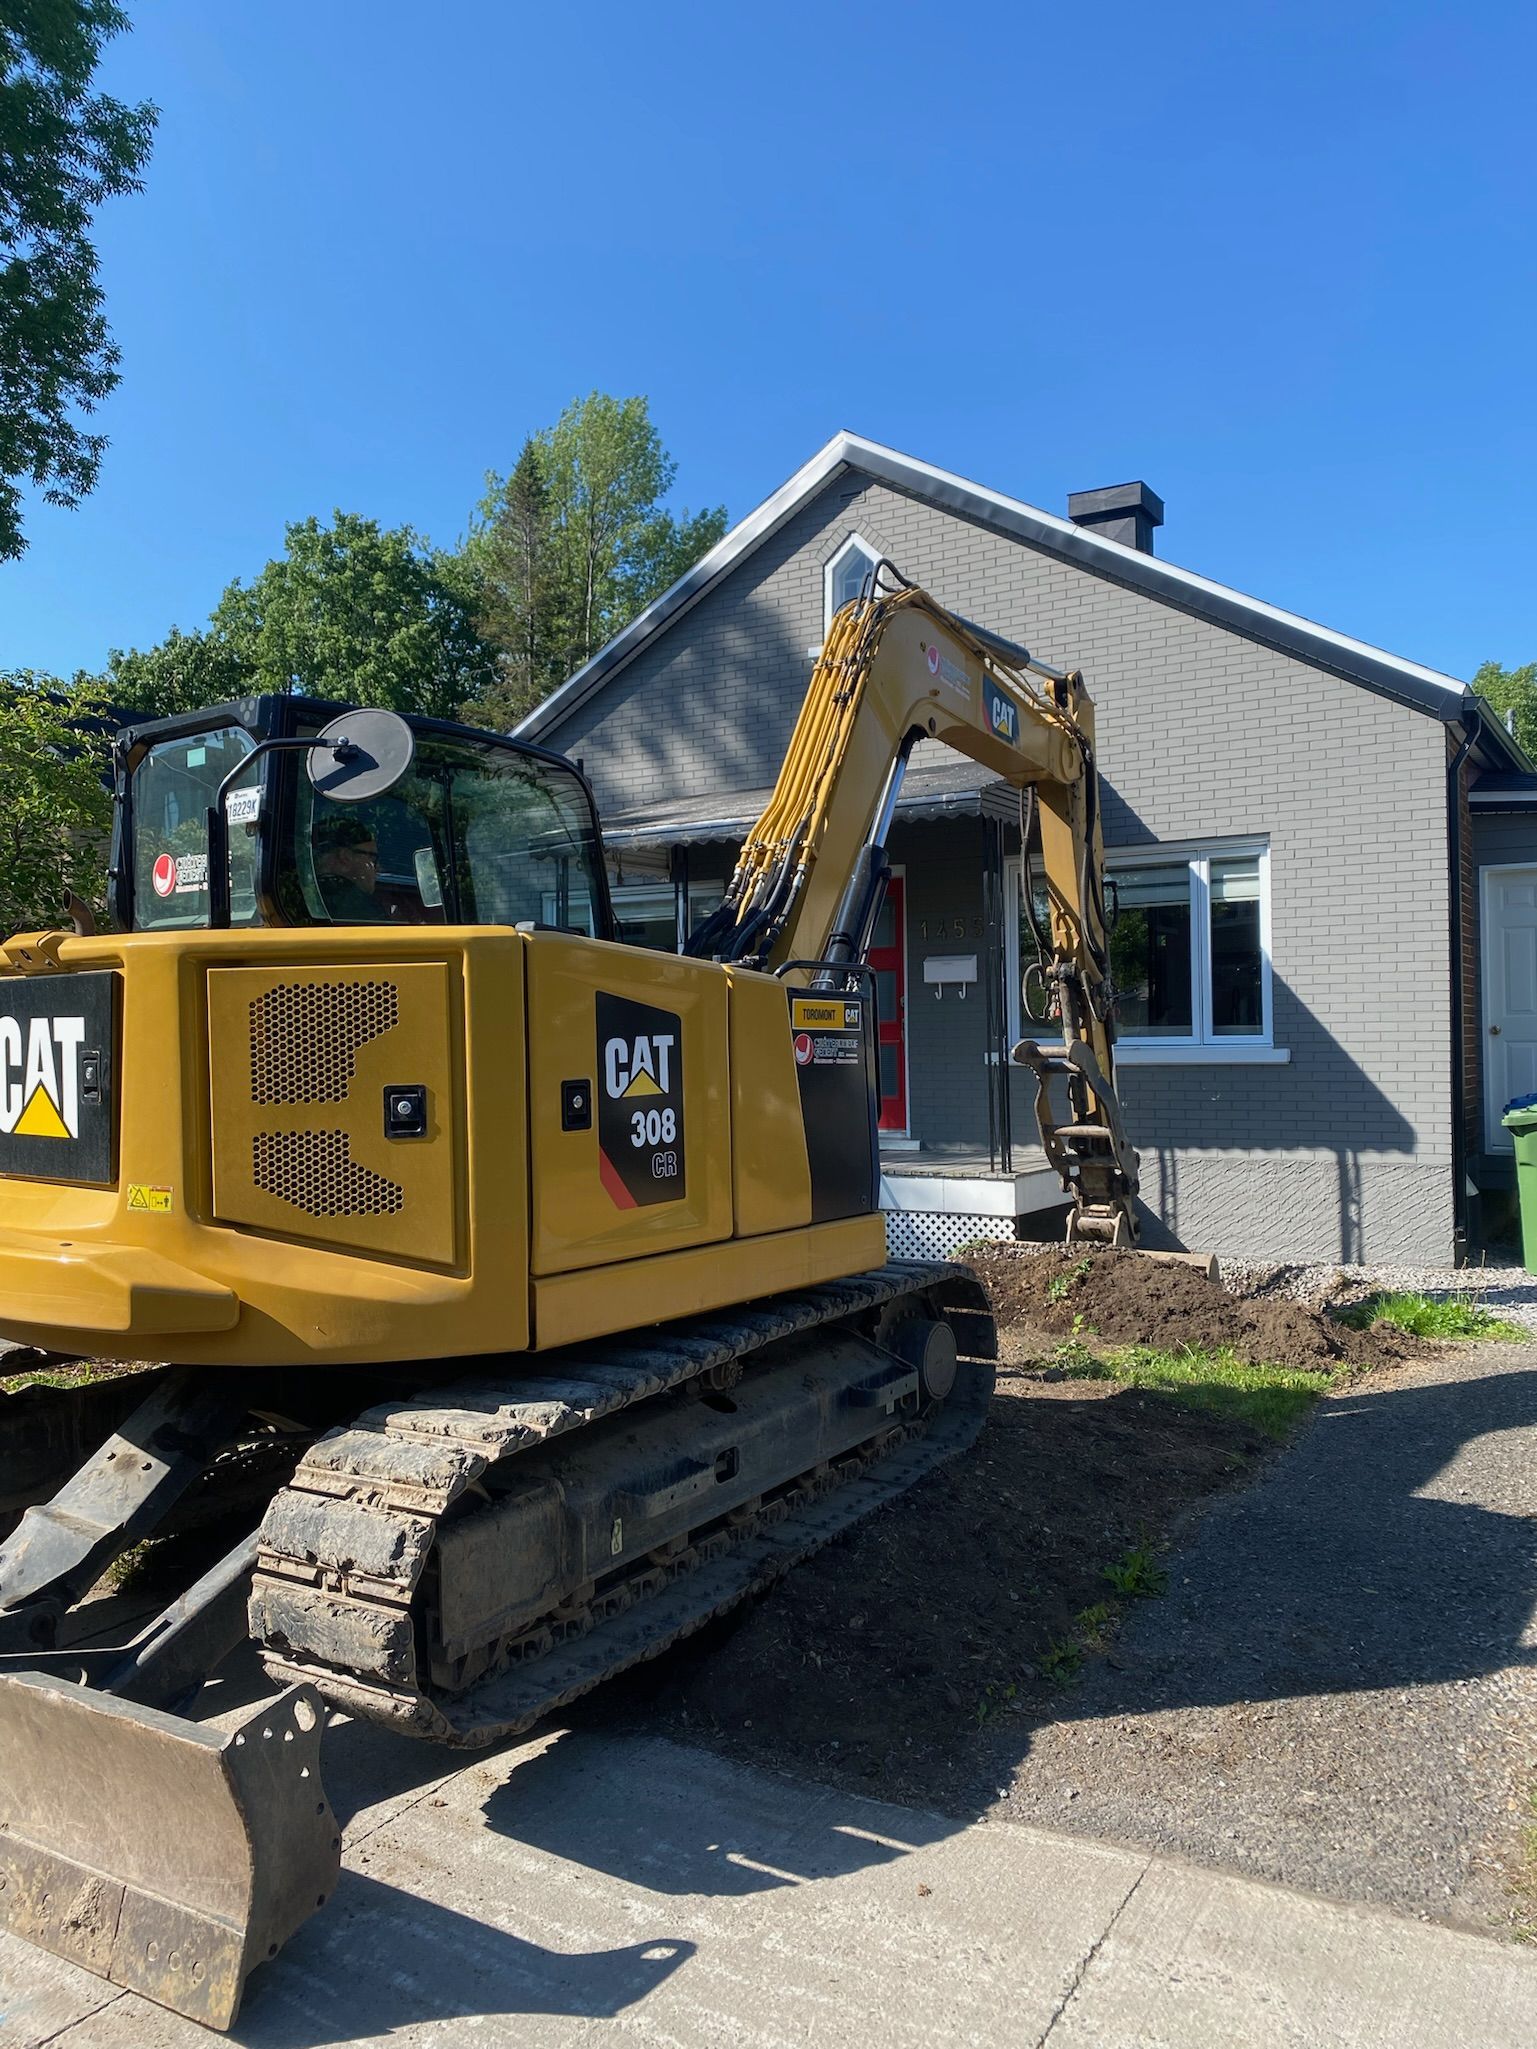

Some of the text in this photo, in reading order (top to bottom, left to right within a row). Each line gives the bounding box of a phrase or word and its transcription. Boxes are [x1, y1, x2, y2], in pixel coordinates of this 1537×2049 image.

[993, 696, 1015, 738] CAT
[802, 1008, 836, 1021] TOROMONT
[845, 1008, 859, 1023] CAT
[0, 1016, 85, 1139] CAT
[605, 1035, 675, 1099] CAT
[631, 1108, 677, 1148] 308
[652, 1151, 678, 1179] CR
